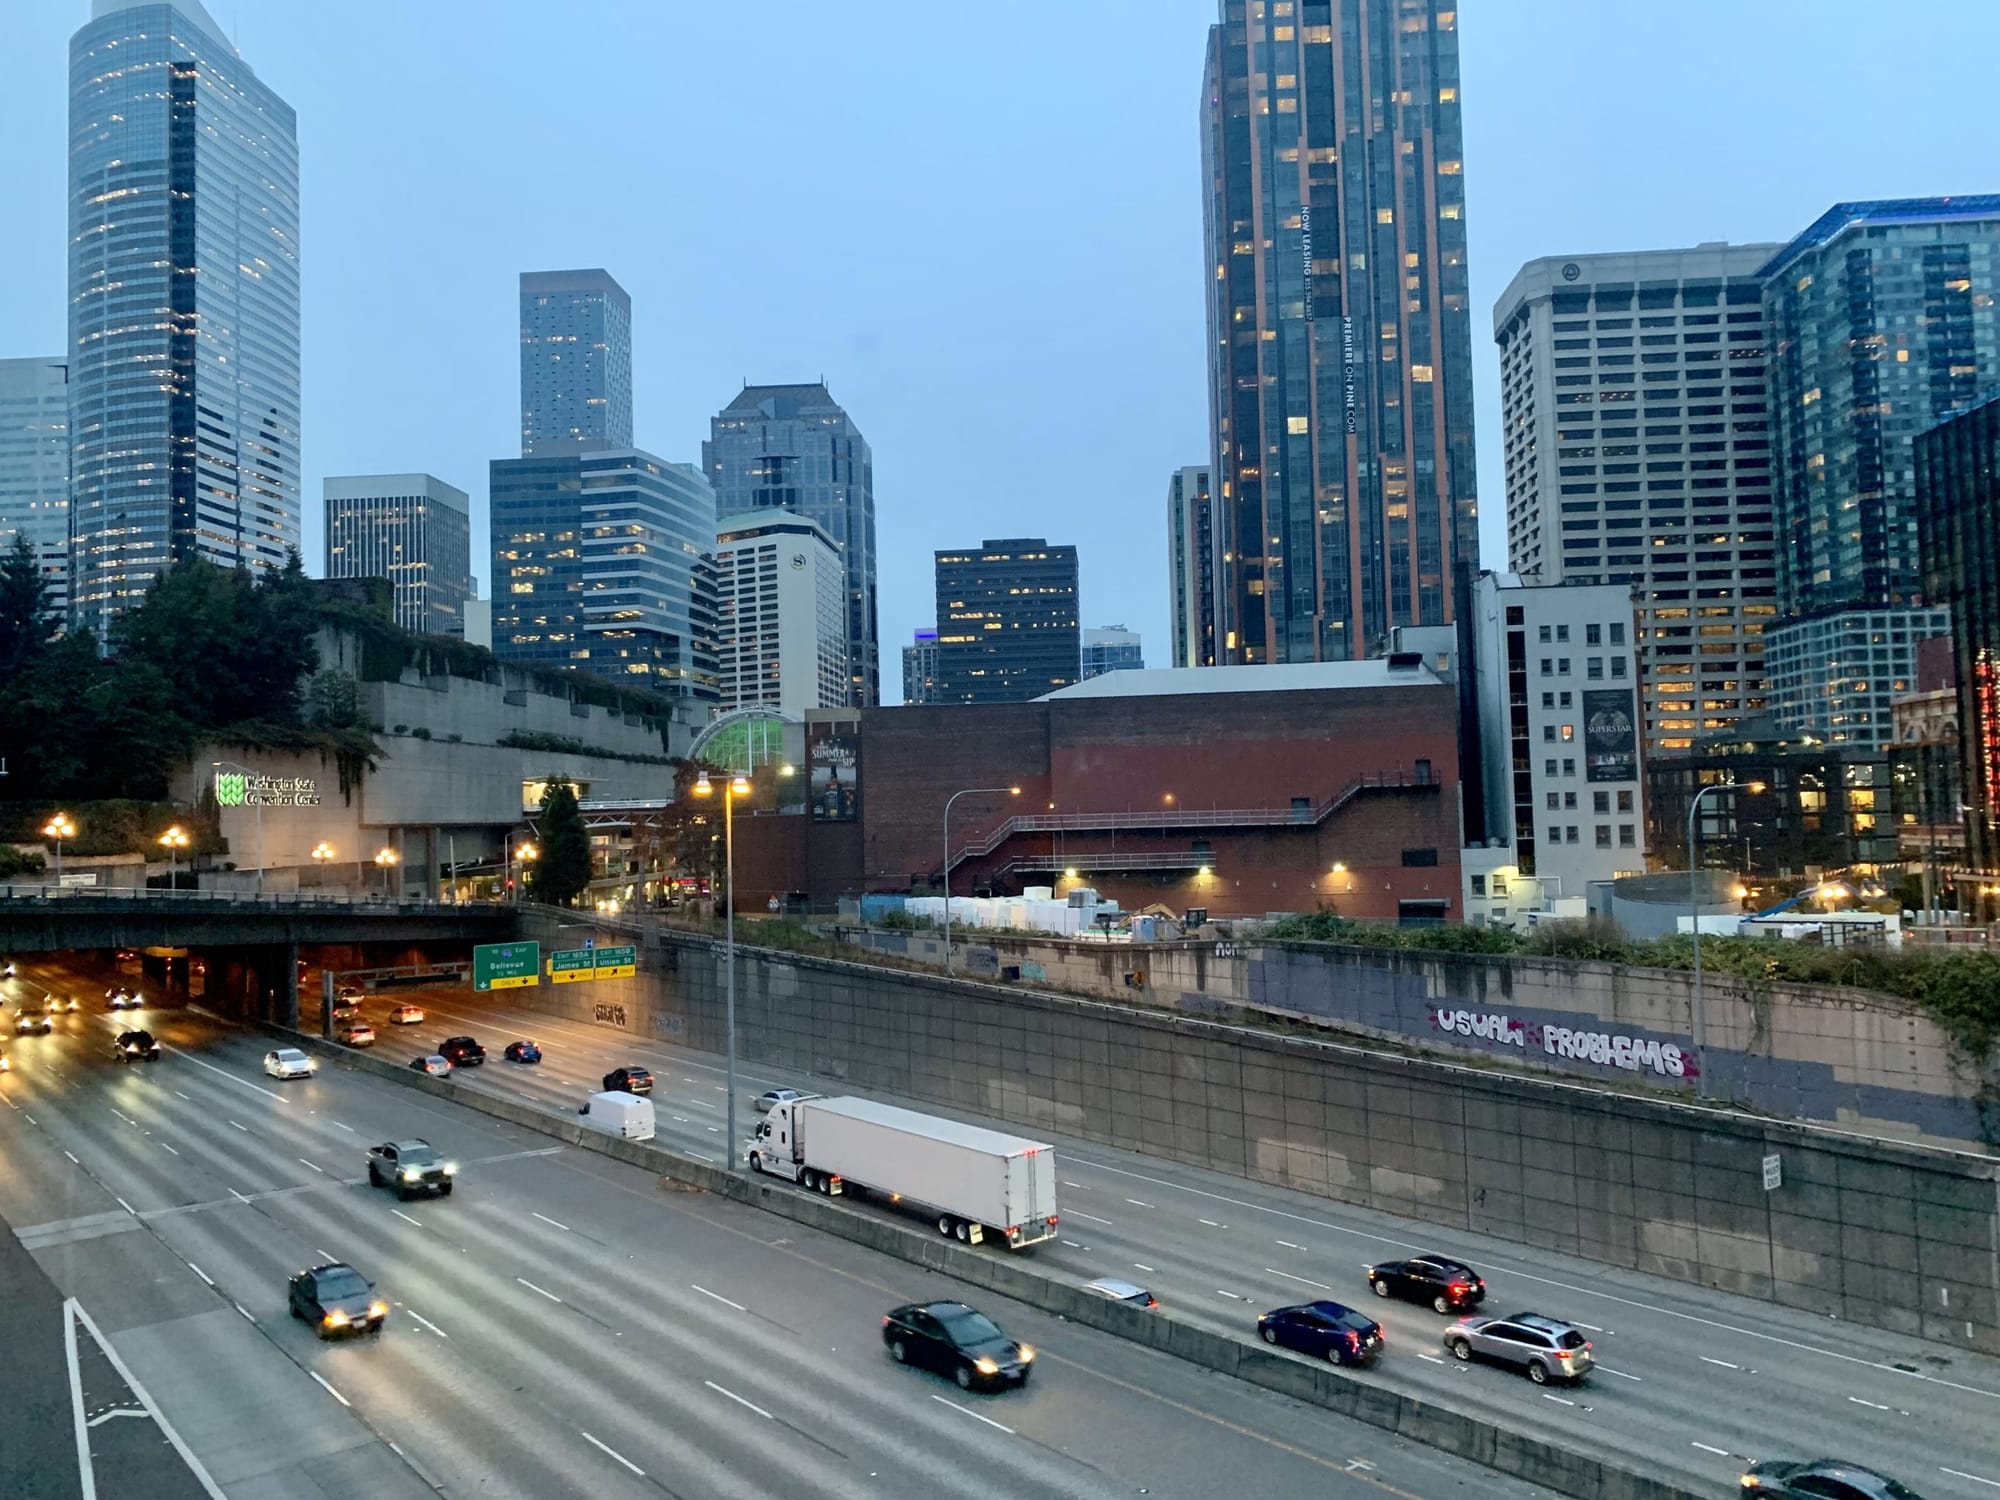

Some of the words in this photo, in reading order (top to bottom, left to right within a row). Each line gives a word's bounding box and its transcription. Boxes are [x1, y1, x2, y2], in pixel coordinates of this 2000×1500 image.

[1301, 206, 1310, 232] NOW
[1303, 235, 1312, 276] LEASING
[1343, 317, 1352, 364] PREMIERE
[1345, 367, 1354, 382] ON
[1588, 725, 1632, 734] SUPERSTAR
[812, 748, 845, 759] SUMMER
[245, 776, 293, 794] Washington
[296, 777, 316, 791] State
[245, 791, 293, 806] Convention
[296, 792, 320, 806] Center
[490, 961, 524, 970] Bellevue
[555, 962, 580, 970] James
[1437, 1008, 1524, 1047] USUAL
[1543, 1024, 1685, 1078] PROBLEMS
[1768, 1176, 1778, 1187] EXIT
